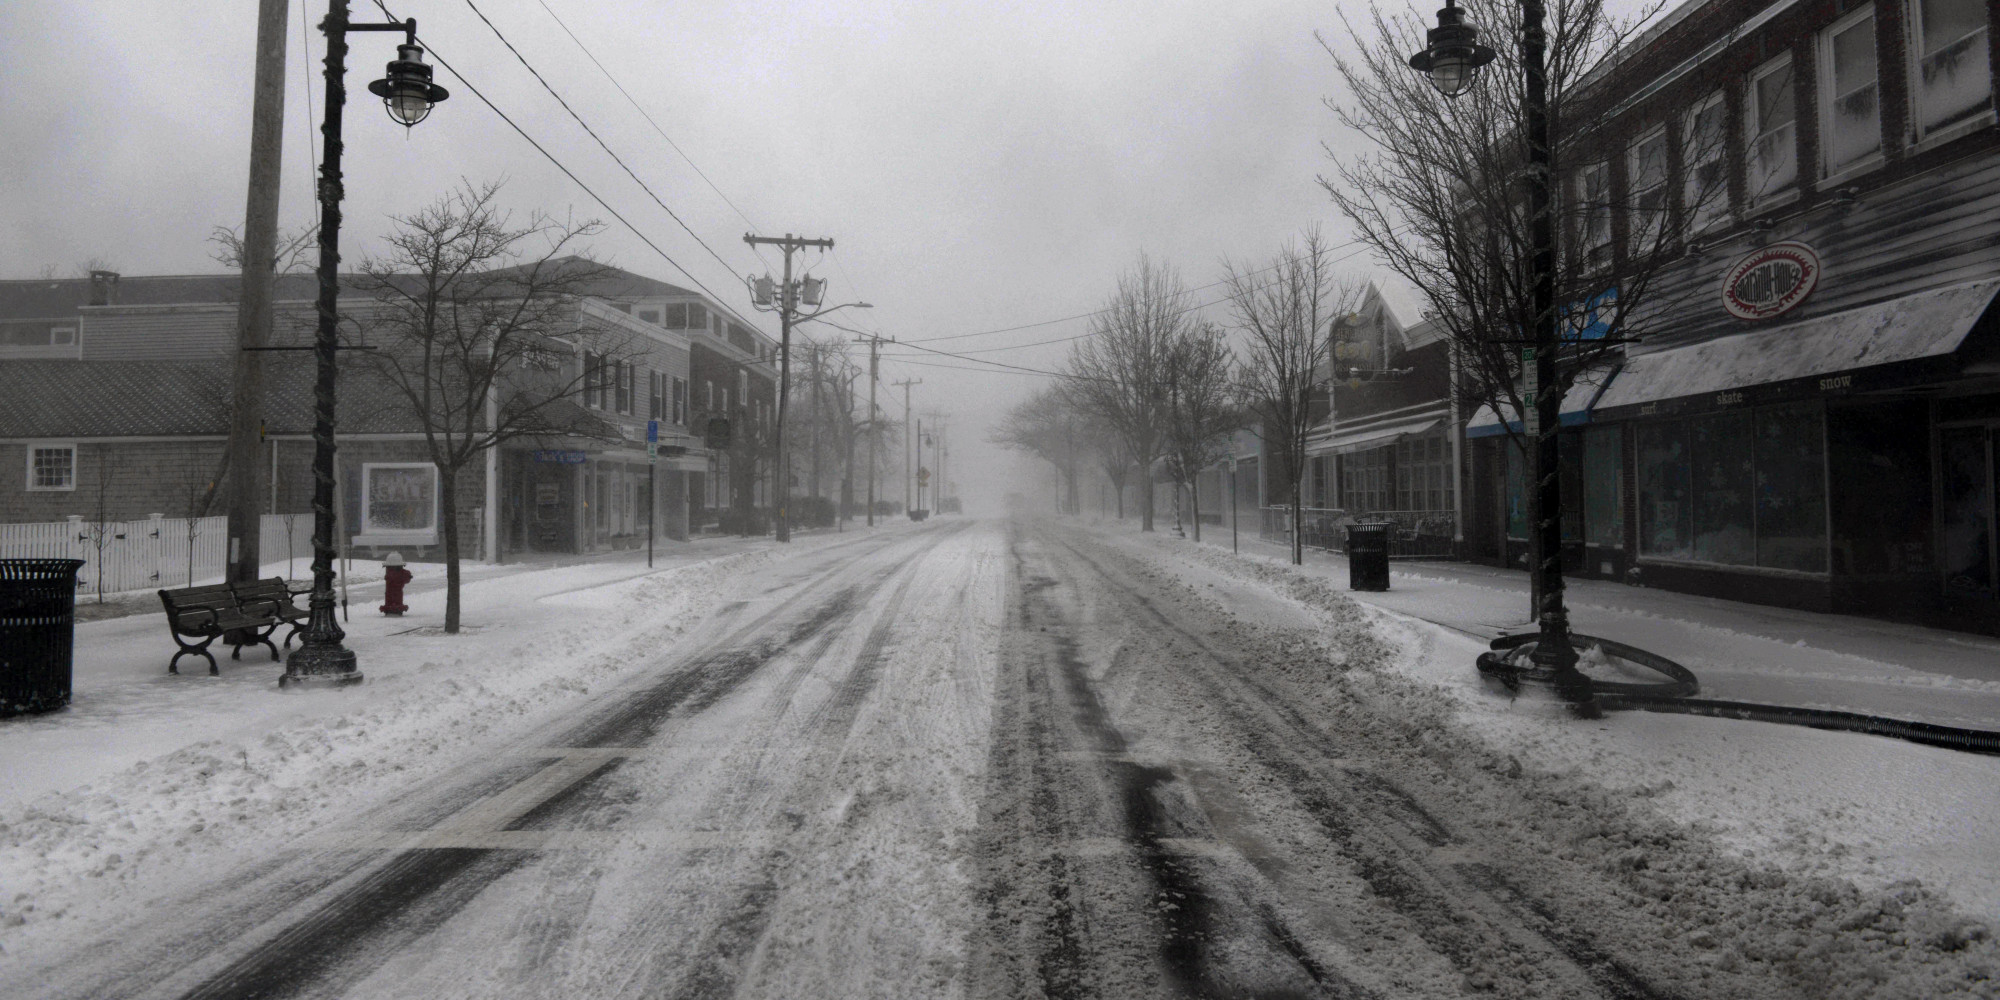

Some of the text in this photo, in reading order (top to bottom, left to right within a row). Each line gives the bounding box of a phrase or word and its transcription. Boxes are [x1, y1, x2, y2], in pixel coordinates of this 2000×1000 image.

[1819, 374, 1852, 390] snow
[1716, 390, 1743, 405] skate
[1640, 402, 1657, 415] surf
